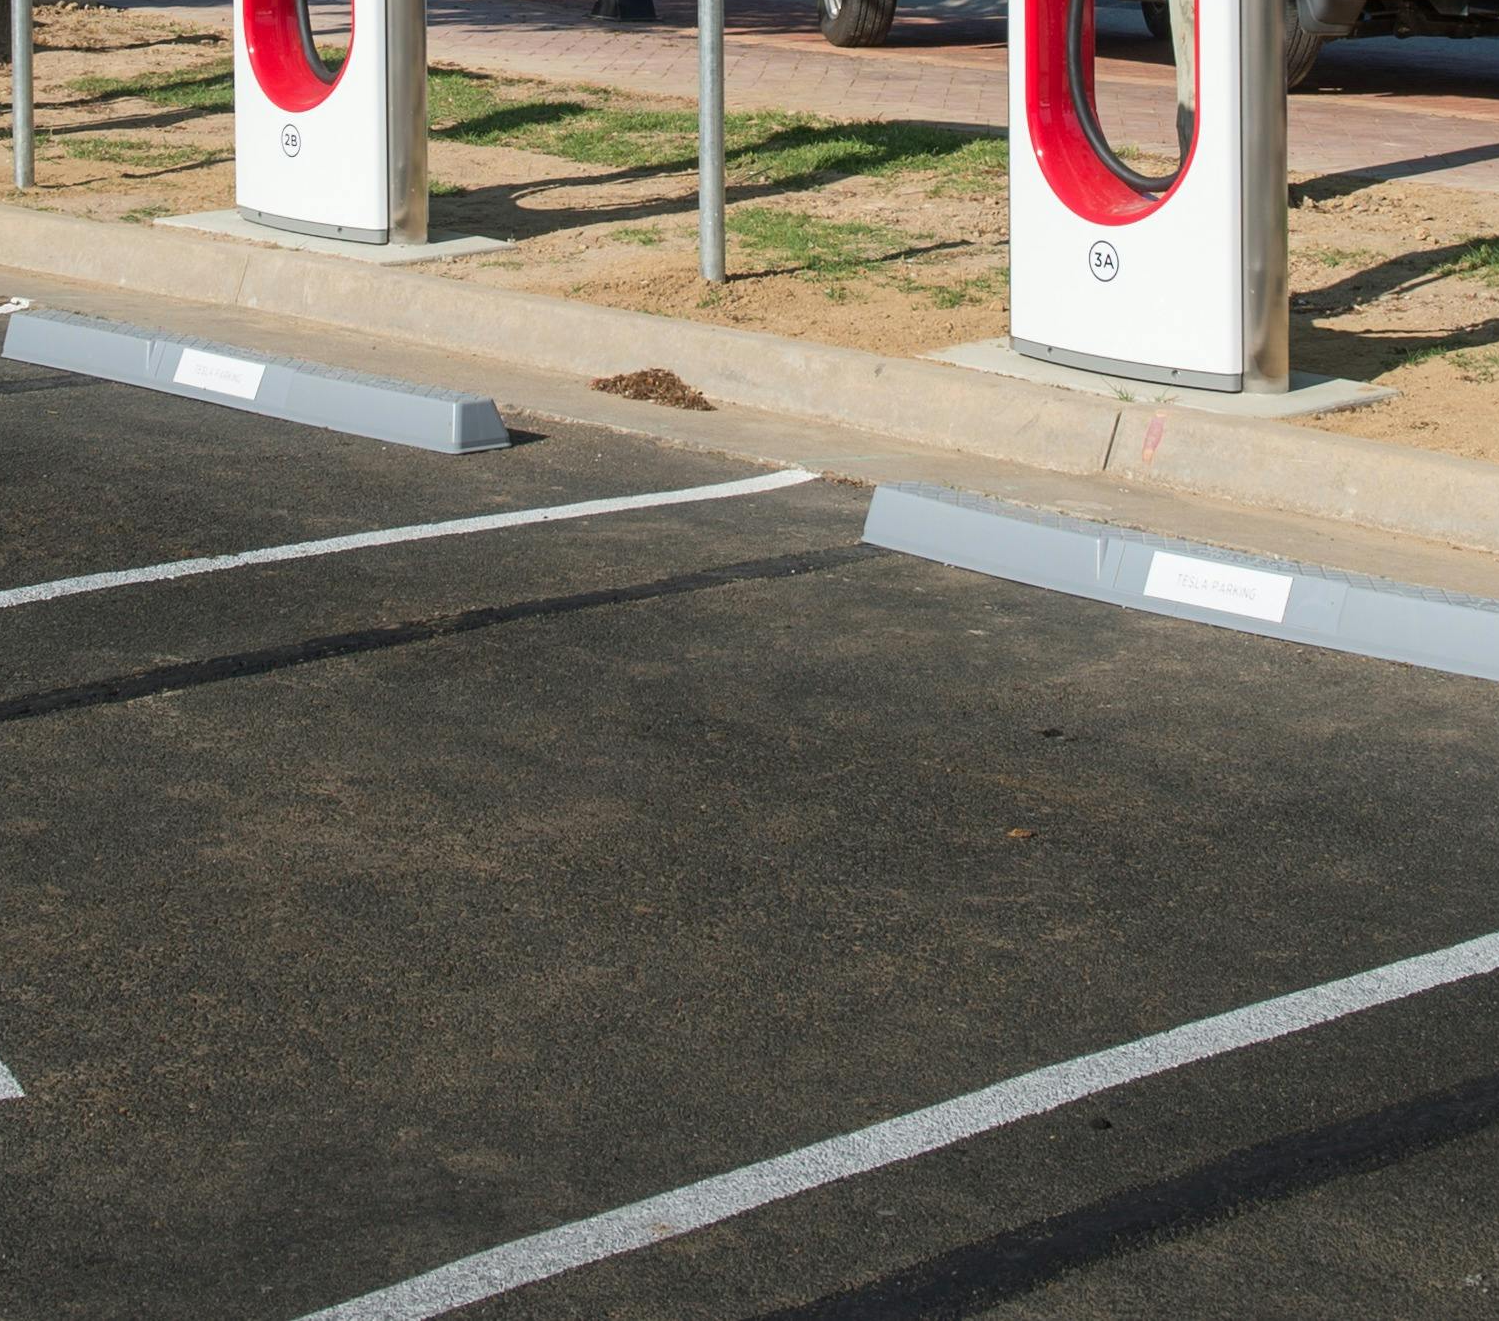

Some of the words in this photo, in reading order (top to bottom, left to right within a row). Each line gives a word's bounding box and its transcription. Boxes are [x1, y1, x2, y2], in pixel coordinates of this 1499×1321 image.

[285, 133, 298, 147] 2B
[1094, 252, 1114, 269] 3A
[1177, 573, 1208, 590] TESLA
[1211, 580, 1257, 600] PARKING
